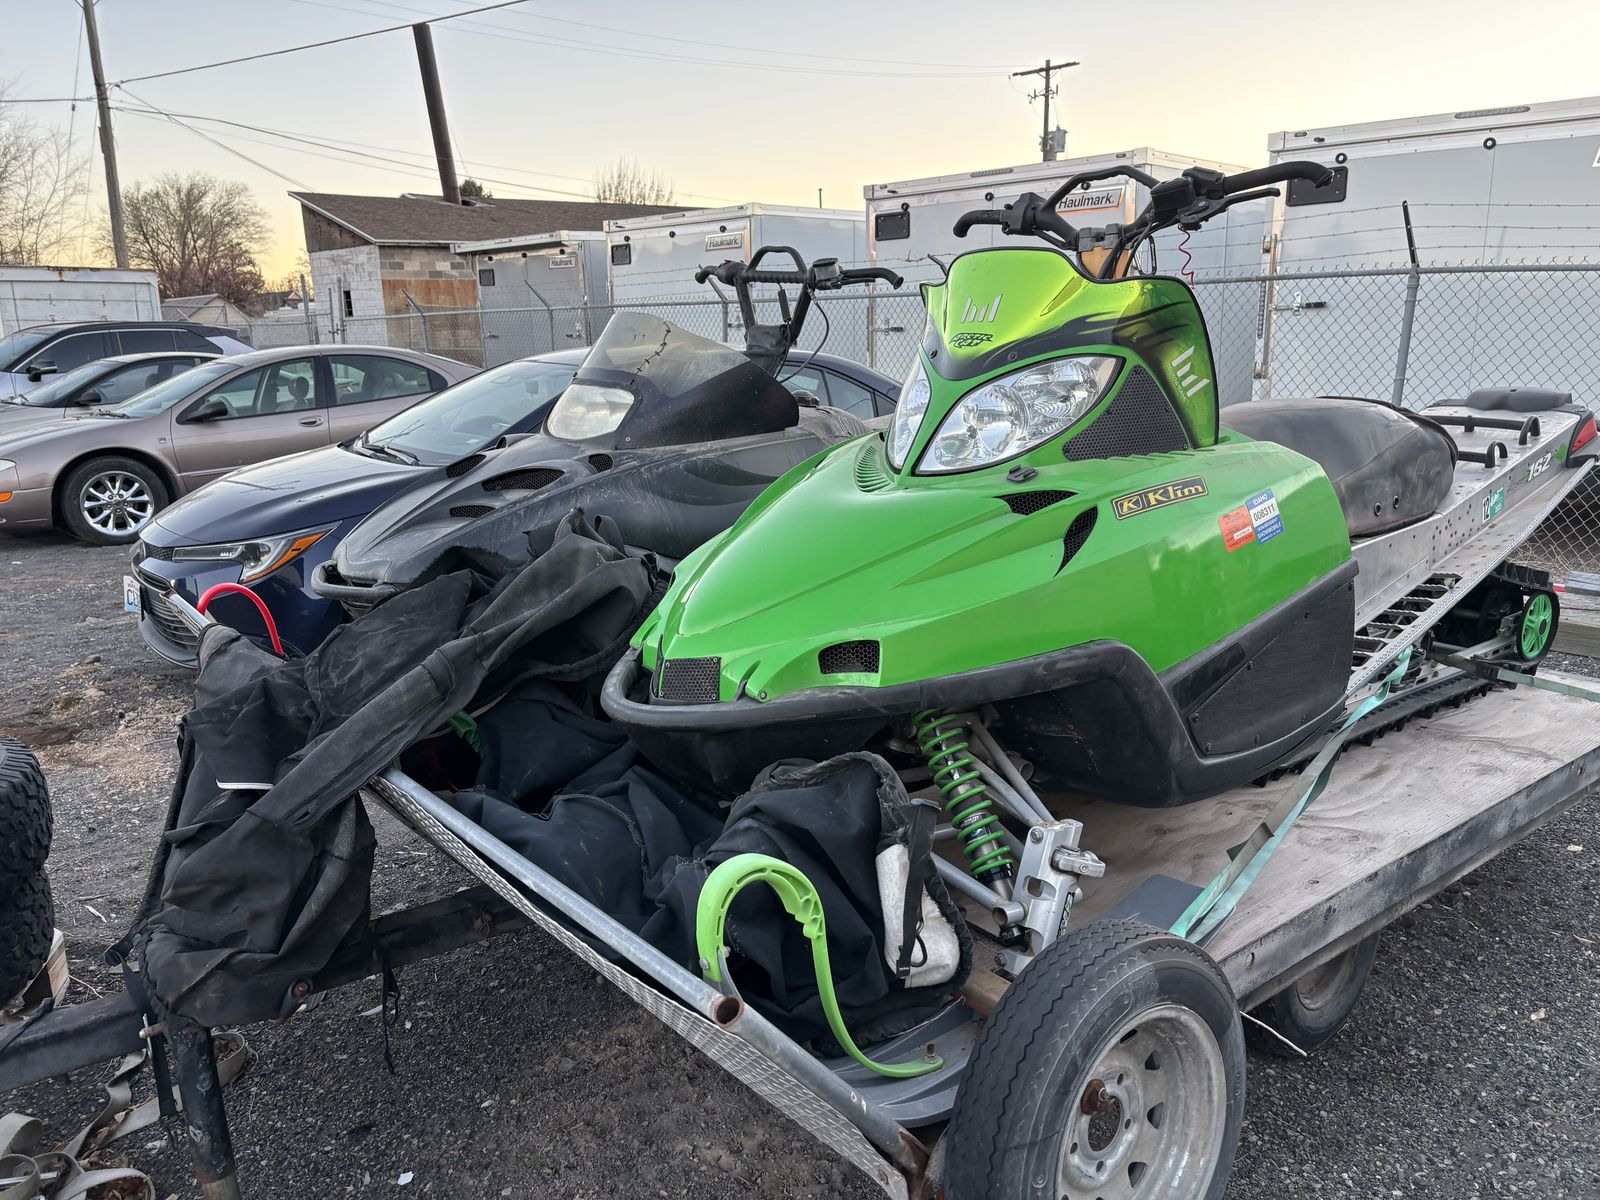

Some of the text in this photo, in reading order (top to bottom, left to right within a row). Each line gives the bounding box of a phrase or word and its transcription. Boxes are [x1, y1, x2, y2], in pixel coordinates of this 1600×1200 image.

[1057, 192, 1113, 208] Haulmark
[709, 237, 738, 247] Haulmark
[1252, 493, 1268, 506] IDAHO
[1253, 503, 1276, 522] 008311
